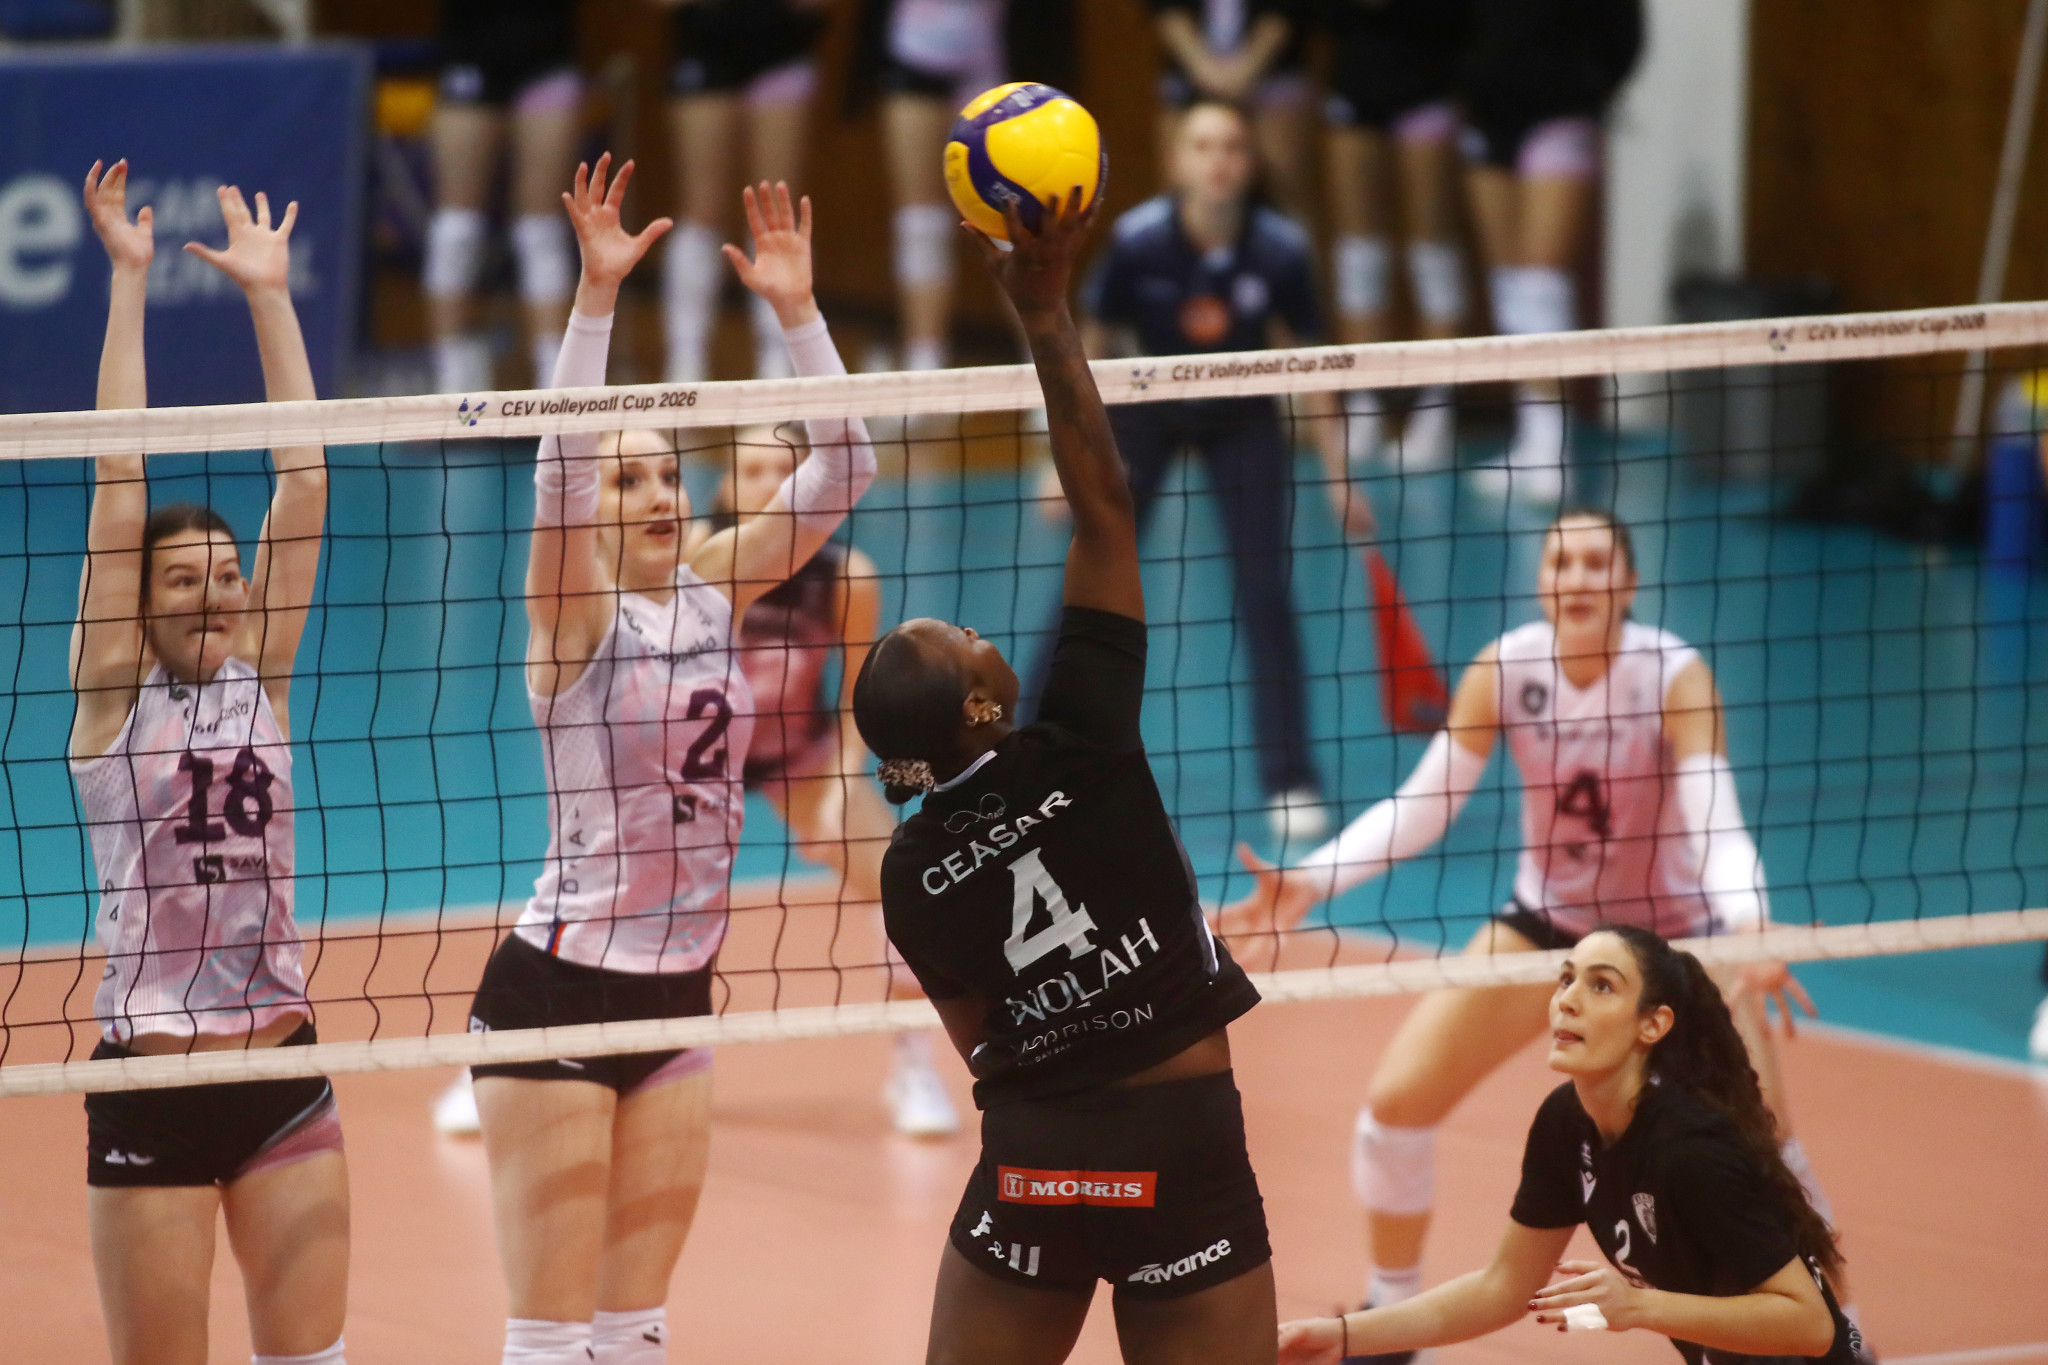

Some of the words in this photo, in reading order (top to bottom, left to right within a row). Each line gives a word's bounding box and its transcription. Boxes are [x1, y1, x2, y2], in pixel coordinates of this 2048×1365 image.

[1171, 364, 1207, 381] CEV
[1208, 357, 1283, 380] Volleyball
[1286, 356, 1318, 374] Cup
[1321, 353, 1356, 371] 2026
[501, 400, 536, 417] CEV
[540, 394, 618, 417] Volleyball
[622, 393, 655, 413] Cup
[659, 390, 698, 408] 2026
[681, 688, 733, 784] 2
[174, 748, 275, 845] 18
[1555, 770, 1613, 839] 4
[922, 790, 1073, 895] CEASAR
[1003, 846, 1099, 976] 4
[1005, 917, 1160, 1026] NOLAH
[1029, 1180, 1142, 1198] MORRIS
[1141, 1238, 1232, 1284] avance
[1615, 1219, 1642, 1277] 2
